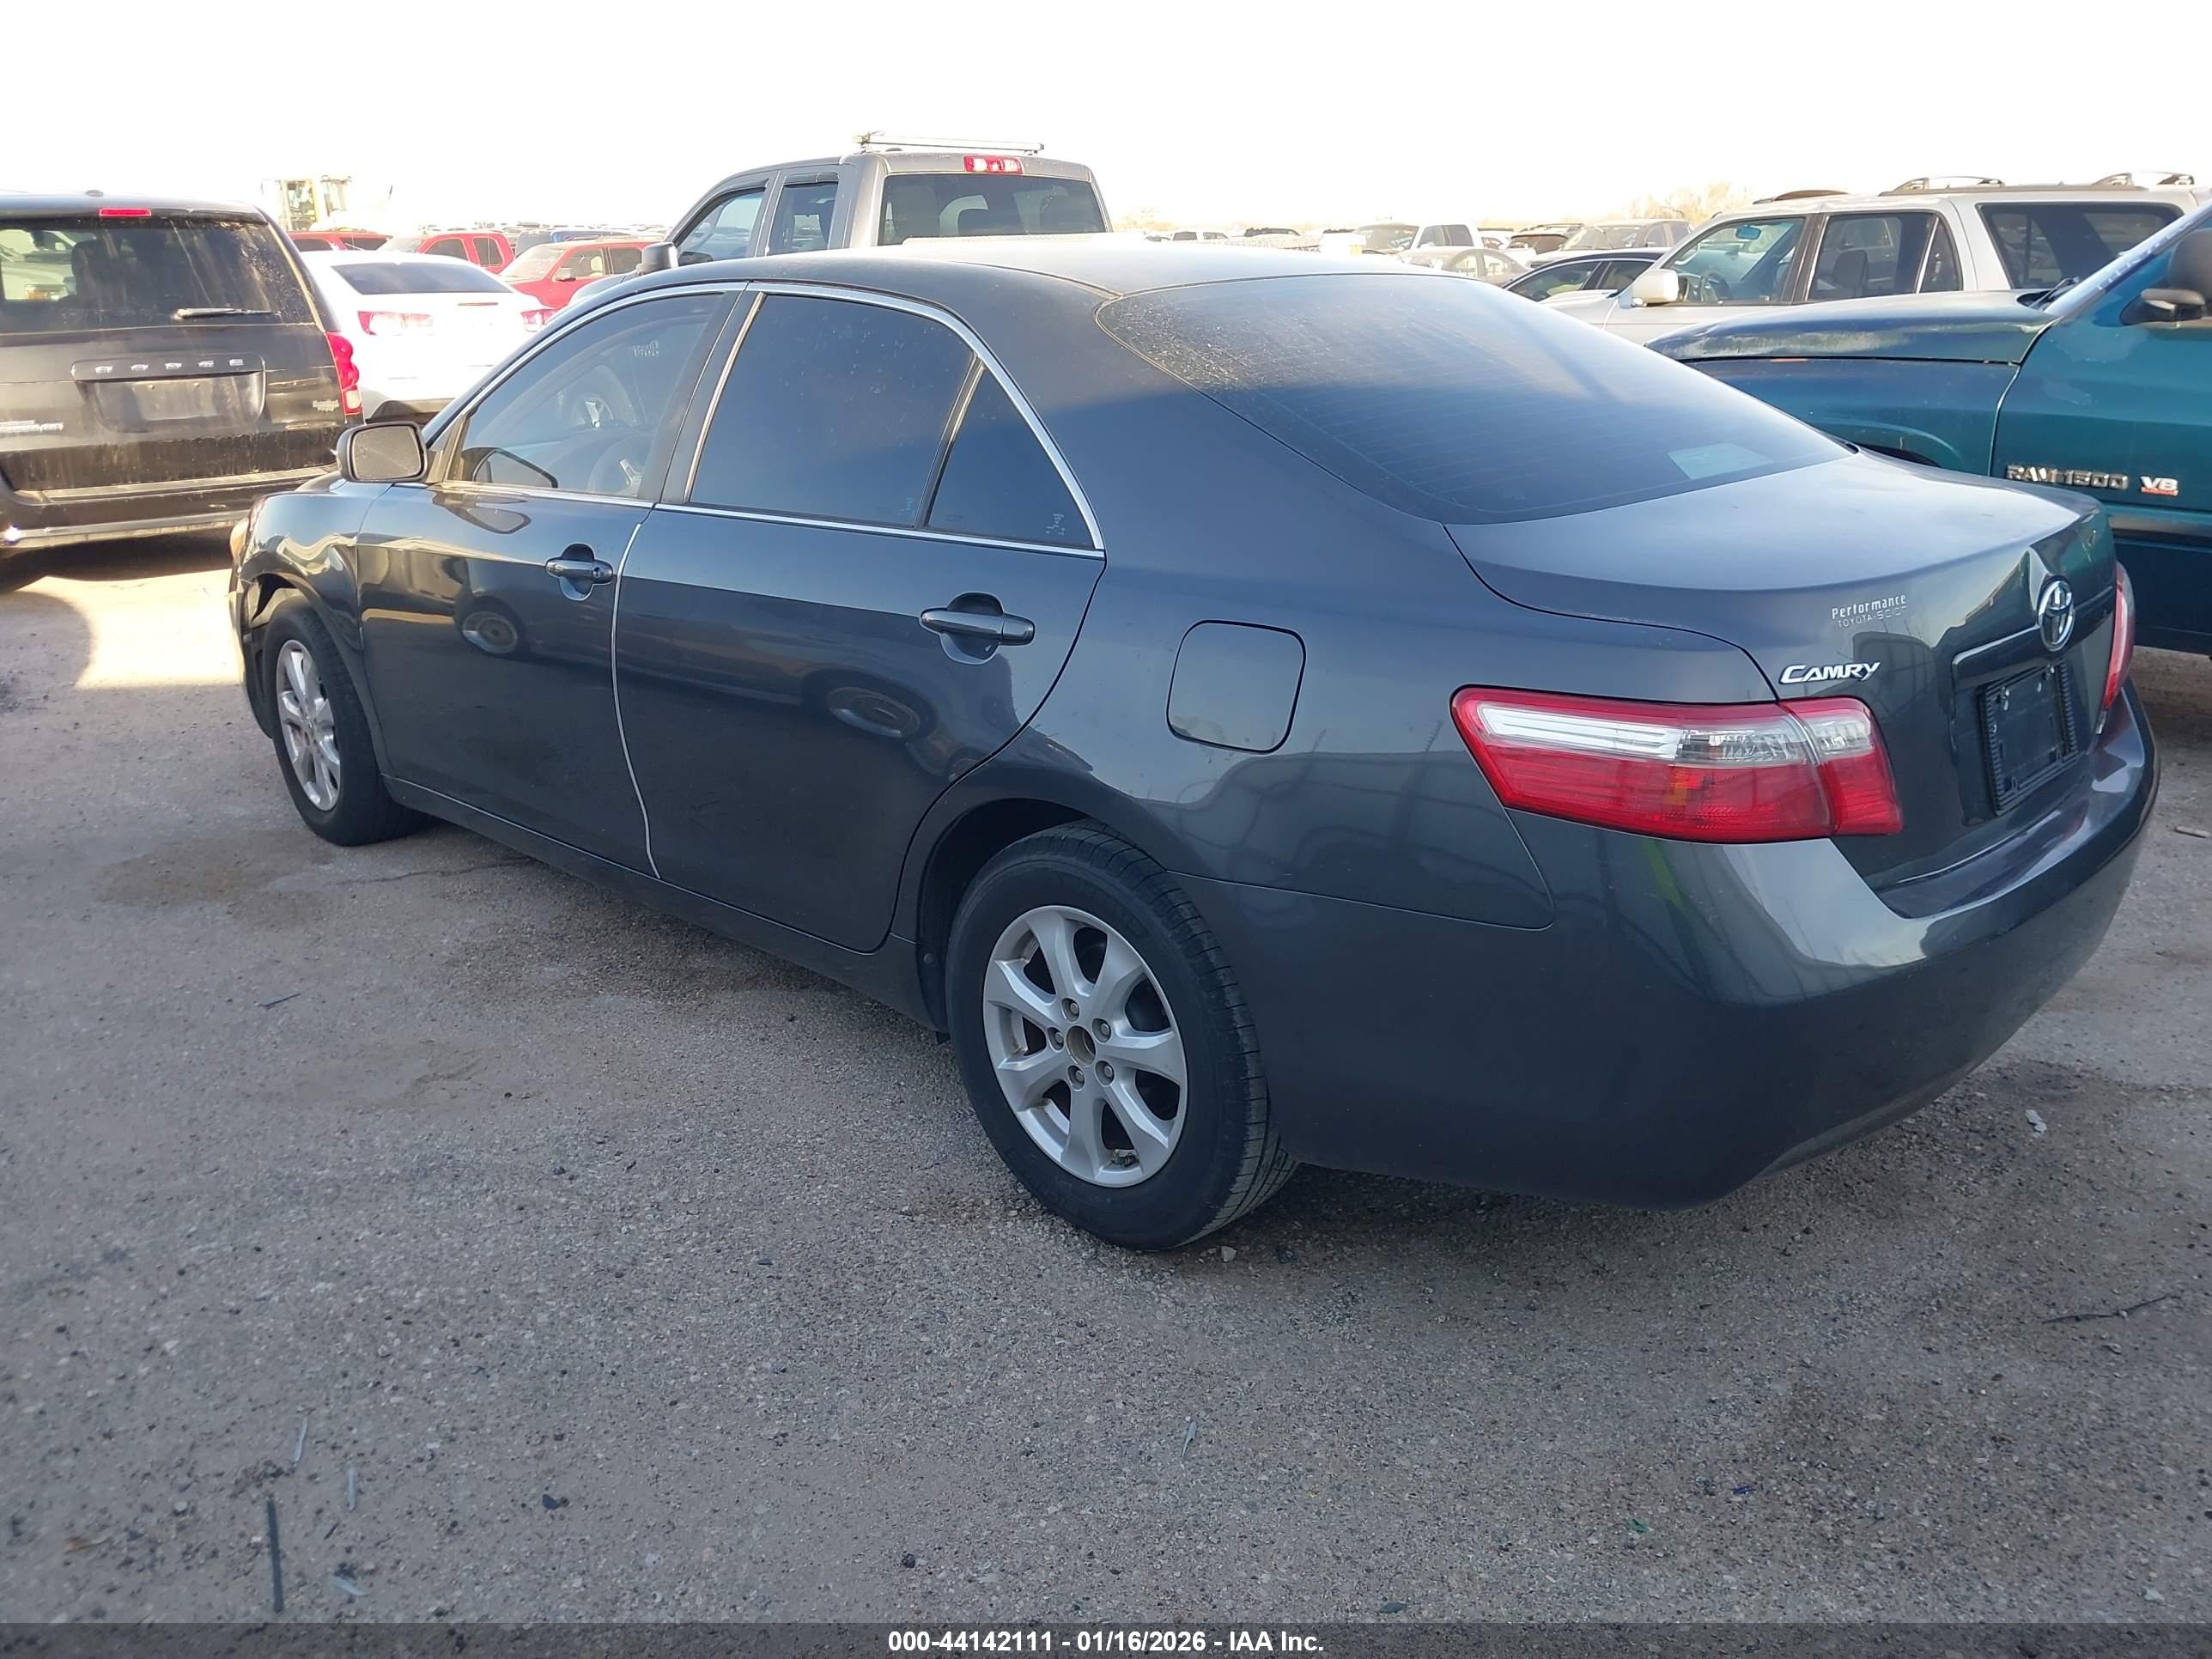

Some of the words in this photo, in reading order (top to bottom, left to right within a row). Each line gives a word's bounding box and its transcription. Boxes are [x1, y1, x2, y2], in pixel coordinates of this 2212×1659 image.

[2062, 470, 2129, 490] 1500
[2139, 475, 2179, 491] V8
[1831, 594, 1906, 619] Performance
[1779, 661, 1881, 684] CAMRY
